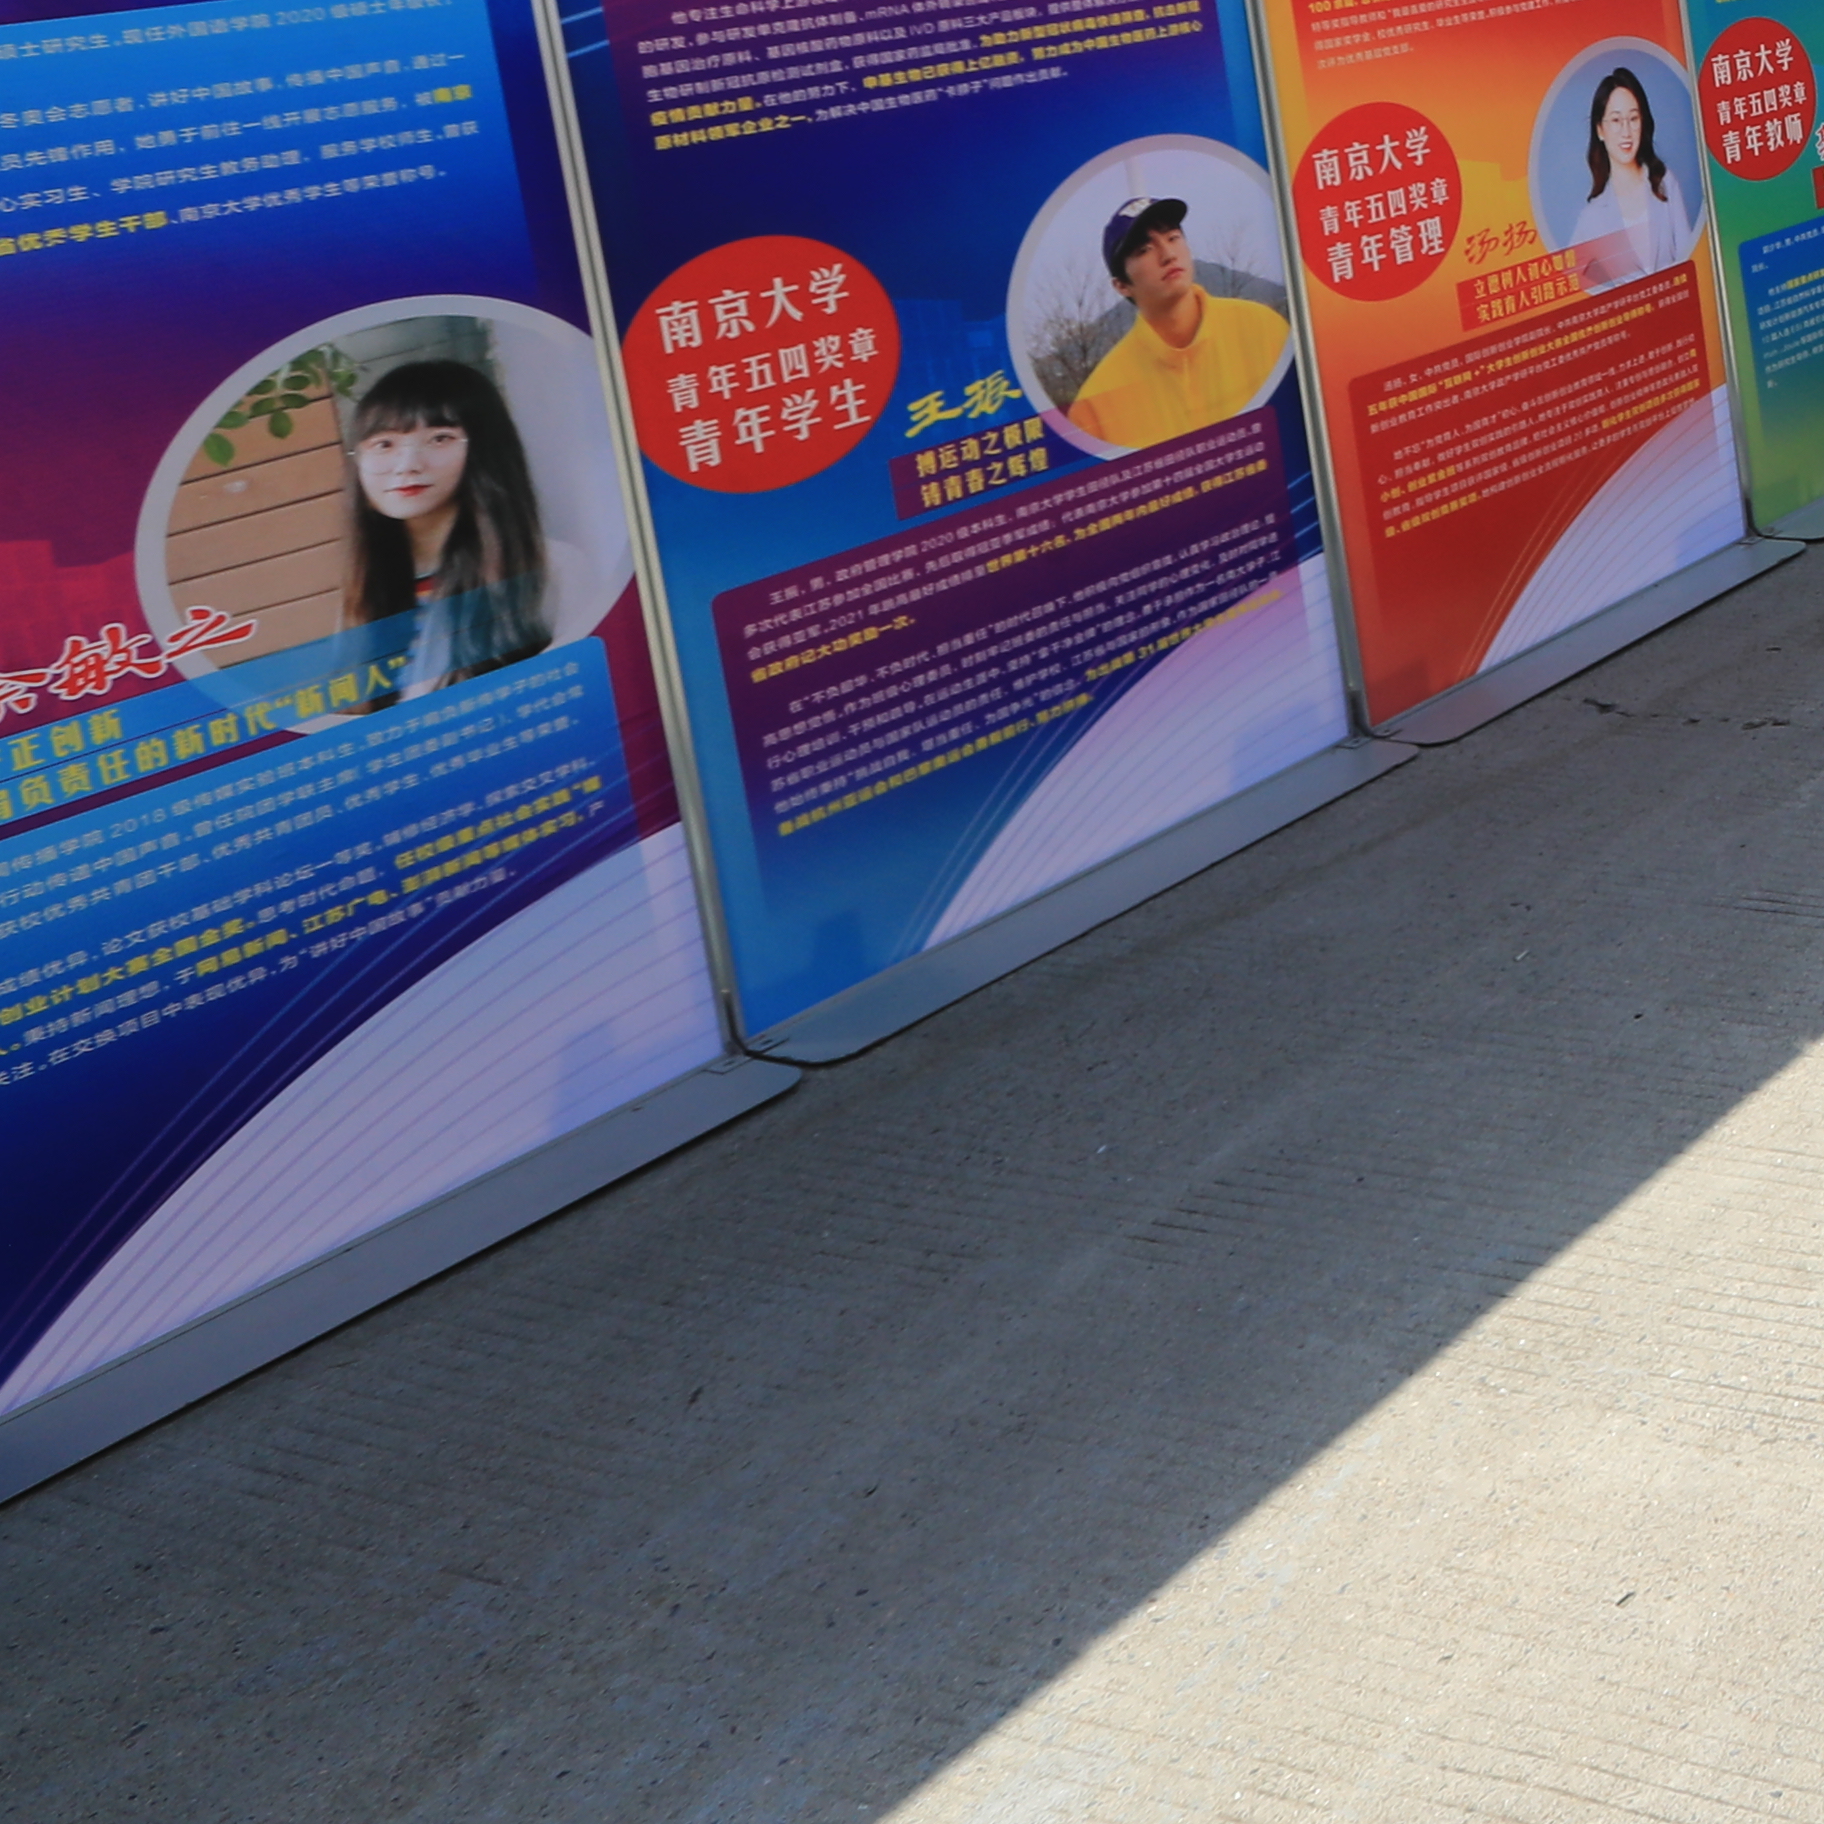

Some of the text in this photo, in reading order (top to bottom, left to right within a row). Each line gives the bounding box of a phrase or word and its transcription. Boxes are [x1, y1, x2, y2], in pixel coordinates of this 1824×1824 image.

[1710, 37, 1794, 86] 南京大学
[1716, 78, 1807, 127] 青年五四奖章
[1311, 123, 1432, 192] 南京大学
[1720, 109, 1805, 166] 青年教师
[1318, 174, 1450, 239] 青年五四奖章
[1325, 213, 1446, 286] 青年管理
[654, 262, 852, 355] 南京大学
[664, 324, 879, 414] 青年五四奖章
[676, 374, 871, 475] 青年学生
